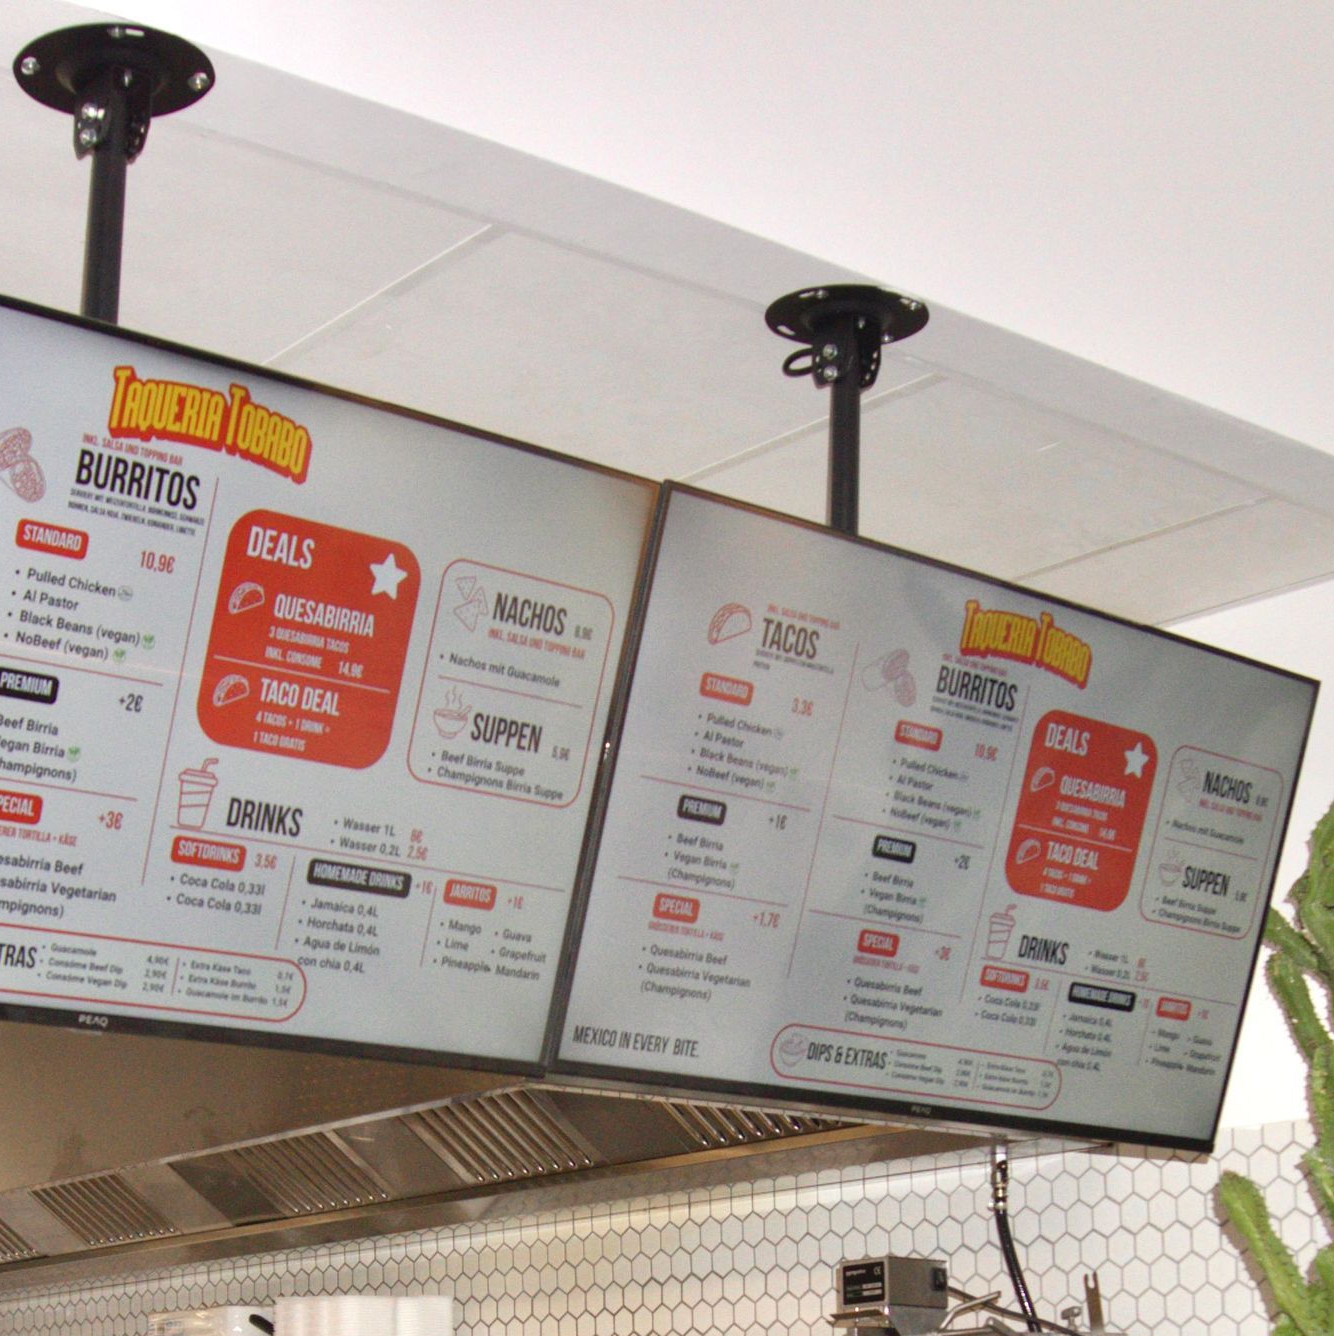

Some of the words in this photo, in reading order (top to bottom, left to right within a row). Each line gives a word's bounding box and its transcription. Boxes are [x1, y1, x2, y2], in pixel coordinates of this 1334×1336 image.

[109, 366, 226, 442] TAQUERIA
[227, 384, 311, 478] TOBABO
[74, 448, 200, 511] BURRITOS
[22, 523, 82, 551] STANDARD
[246, 525, 315, 569] DEALS
[140, 550, 176, 574] 10,9€
[26, 567, 66, 587] Pulled
[67, 576, 116, 597] Chicken
[22, 588, 37, 602] Al
[38, 591, 79, 611] Pastor
[273, 593, 374, 637] QUESABIRRIA
[491, 591, 567, 636] NACHOS
[18, 608, 53, 628] Black
[55, 616, 93, 636] Beans
[95, 624, 141, 647] (vegan)
[761, 617, 820, 660] TACOS
[15, 630, 62, 650] NoBeef
[63, 639, 109, 661] (vegan)
[962, 600, 1037, 660] TAQUERIA
[1037, 613, 1092, 687] TOBABO
[448, 651, 487, 671] Nachos
[488, 663, 506, 675] mit
[506, 665, 560, 688] Guacamole
[260, 677, 300, 708] TACO
[300, 686, 339, 716] DEAL
[936, 665, 1018, 712] BURRITOS
[118, 692, 144, 713] +2€
[25, 718, 59, 736] Birria
[470, 712, 543, 753] SUPPEN
[702, 730, 714, 742] Al
[714, 731, 744, 748] Pastor
[1043, 722, 1090, 756] DEALS
[32, 740, 66, 759] Birria
[440, 749, 465, 764] Beef
[465, 754, 493, 770] Birria
[494, 760, 525, 777] Suppe
[1059, 774, 1126, 808] QUESABIRRIA
[1202, 770, 1253, 804] NACHOS
[98, 809, 124, 831] +3€
[225, 796, 303, 838] DRINKS
[342, 817, 381, 834] Wasser
[384, 823, 396, 837] 1L
[177, 839, 240, 864] SOFTDRINKS
[339, 836, 377, 853] Wasser
[378, 842, 401, 858] 0,2L
[675, 832, 699, 846] Beef
[698, 836, 724, 852] Birria
[53, 859, 84, 875] Beef
[1046, 840, 1073, 864] TACO
[1071, 846, 1098, 871] DEAL
[179, 872, 209, 888] Coca
[210, 877, 236, 892] Cola
[312, 862, 369, 885] HOMEMADE
[368, 870, 404, 891] DRINKS
[666, 867, 735, 890] (Champignons)
[1181, 864, 1231, 897] SUPPEN
[50, 881, 117, 902] Vegetarian
[175, 892, 205, 908] Coca
[206, 896, 232, 912] Cola
[449, 883, 492, 903] JARRITOS
[310, 897, 355, 914] Jamaica
[658, 897, 693, 917] SPECIAL
[306, 916, 355, 934] Horchata
[447, 918, 482, 936] Mango
[501, 927, 532, 943] Guava
[302, 935, 331, 951] Agua
[332, 939, 346, 952] de
[347, 941, 380, 956] Limón
[444, 937, 469, 952] Lime
[498, 946, 547, 964] Grapefruit
[1017, 934, 1069, 966] DRINKS
[440, 955, 488, 974] Pineapple
[494, 964, 540, 981] Mandarin
[571, 1024, 617, 1047] MEXICO
[617, 1031, 632, 1049] IN
[632, 1032, 669, 1053] EVERY
[672, 1037, 699, 1058] BITE.
[806, 1041, 834, 1062] DIPS
[833, 1045, 843, 1064] &
[843, 1046, 888, 1070] EXTRAS
